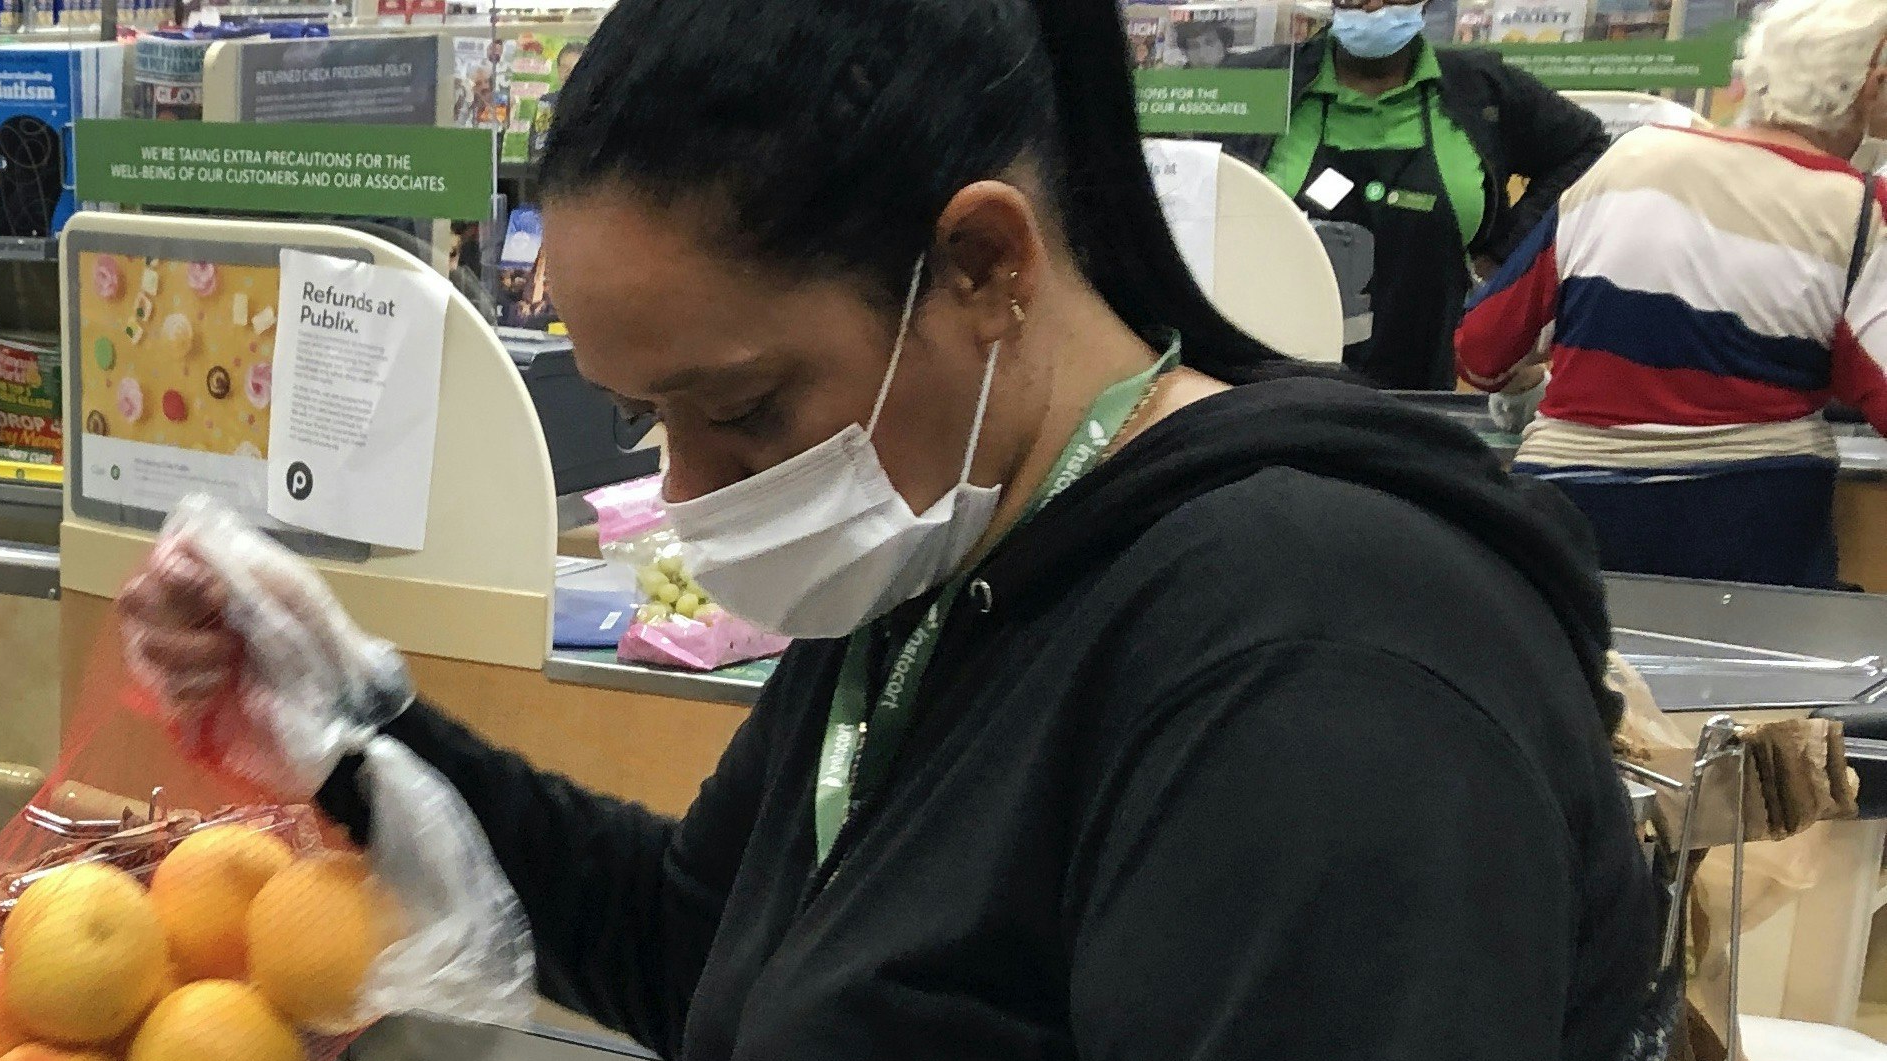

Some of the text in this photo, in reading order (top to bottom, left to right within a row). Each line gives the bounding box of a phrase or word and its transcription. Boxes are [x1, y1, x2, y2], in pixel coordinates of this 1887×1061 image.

[303, 67, 331, 82] CHECK
[141, 146, 411, 170] WE'RE TAKING EXTRA PRECAUTIONS FOR THE
[111, 163, 175, 180] WELL-BEING
[179, 165, 194, 180] OF
[198, 166, 223, 182] OUR
[226, 168, 299, 186] CUSTOMERS
[302, 171, 330, 187] AND
[334, 172, 361, 188] OUR
[303, 281, 395, 317] Refunds at
[300, 305, 360, 334] Publix.
